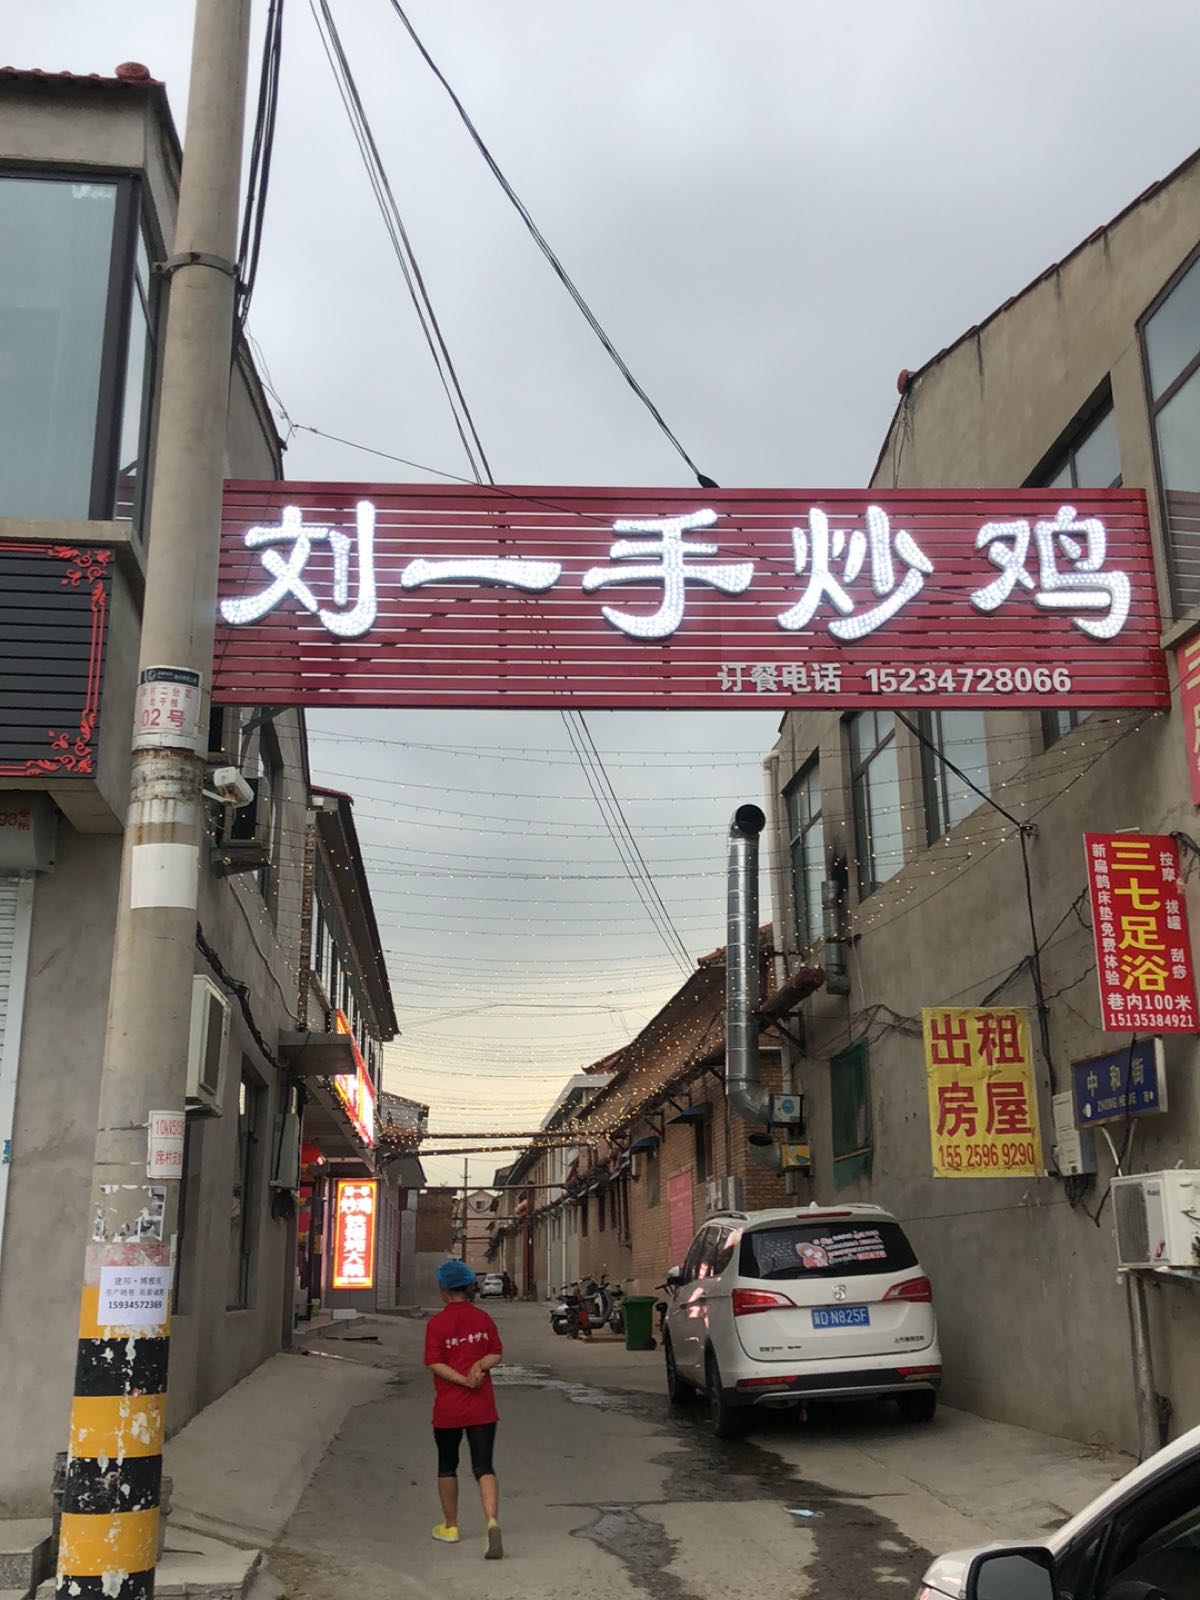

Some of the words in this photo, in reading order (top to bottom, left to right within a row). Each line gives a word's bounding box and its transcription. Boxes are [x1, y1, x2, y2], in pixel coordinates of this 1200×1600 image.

[219, 500, 1132, 641] 刘一手炒鸡
[717, 663, 842, 693] 订餐电话
[865, 667, 1072, 693] 15234728066
[1110, 841, 1169, 991] 三七足浴
[1159, 851, 1178, 882] 按摩
[1170, 948, 1187, 979] 刮痧
[1107, 993, 1192, 1011] 巷内100米
[1110, 1013, 1195, 1028] 15135384921
[930, 1013, 1025, 1067] 出租
[1086, 1057, 1144, 1097] 中和街
[936, 1081, 1032, 1137] 房屋
[938, 1145, 962, 1168] 155
[967, 1144, 999, 1168] 2596
[1003, 1142, 1035, 1167] 9290
